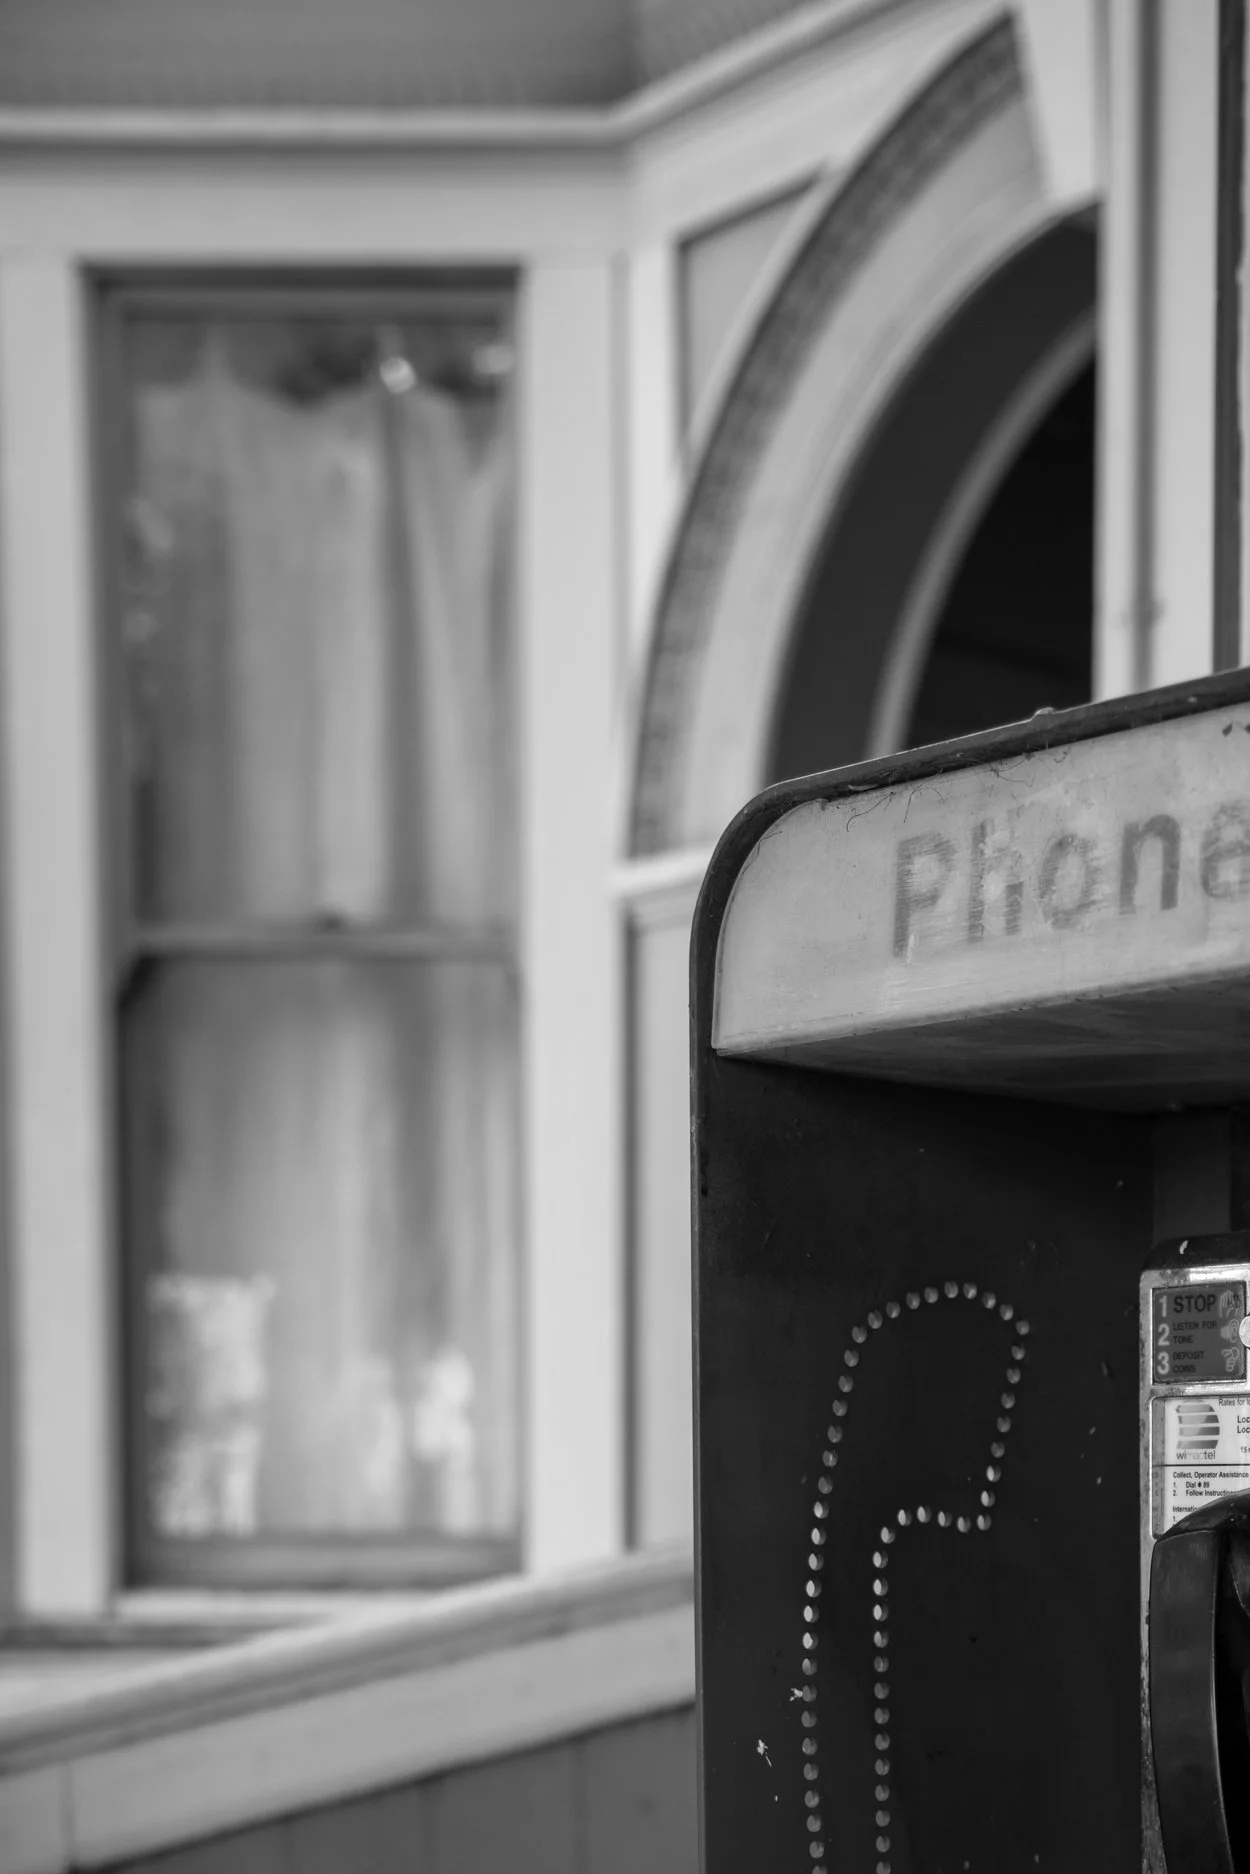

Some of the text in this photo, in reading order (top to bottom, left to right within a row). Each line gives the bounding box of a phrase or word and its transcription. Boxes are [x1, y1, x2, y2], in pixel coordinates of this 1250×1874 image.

[1159, 1294, 1216, 1317] 1 STOP
[1158, 1320, 1217, 1346] 2 LISTEN FOR
[1173, 1335, 1194, 1344] TONE
[1157, 1350, 1205, 1374] 3 DEPOSIT
[1172, 1364, 1196, 1374] COINS
[1218, 1399, 1236, 1407] Rates
[1237, 1398, 1245, 1406] for
[1176, 1450, 1216, 1460] wimactel
[1173, 1471, 1193, 1479] Collect,
[1194, 1471, 1218, 1479] Operator
